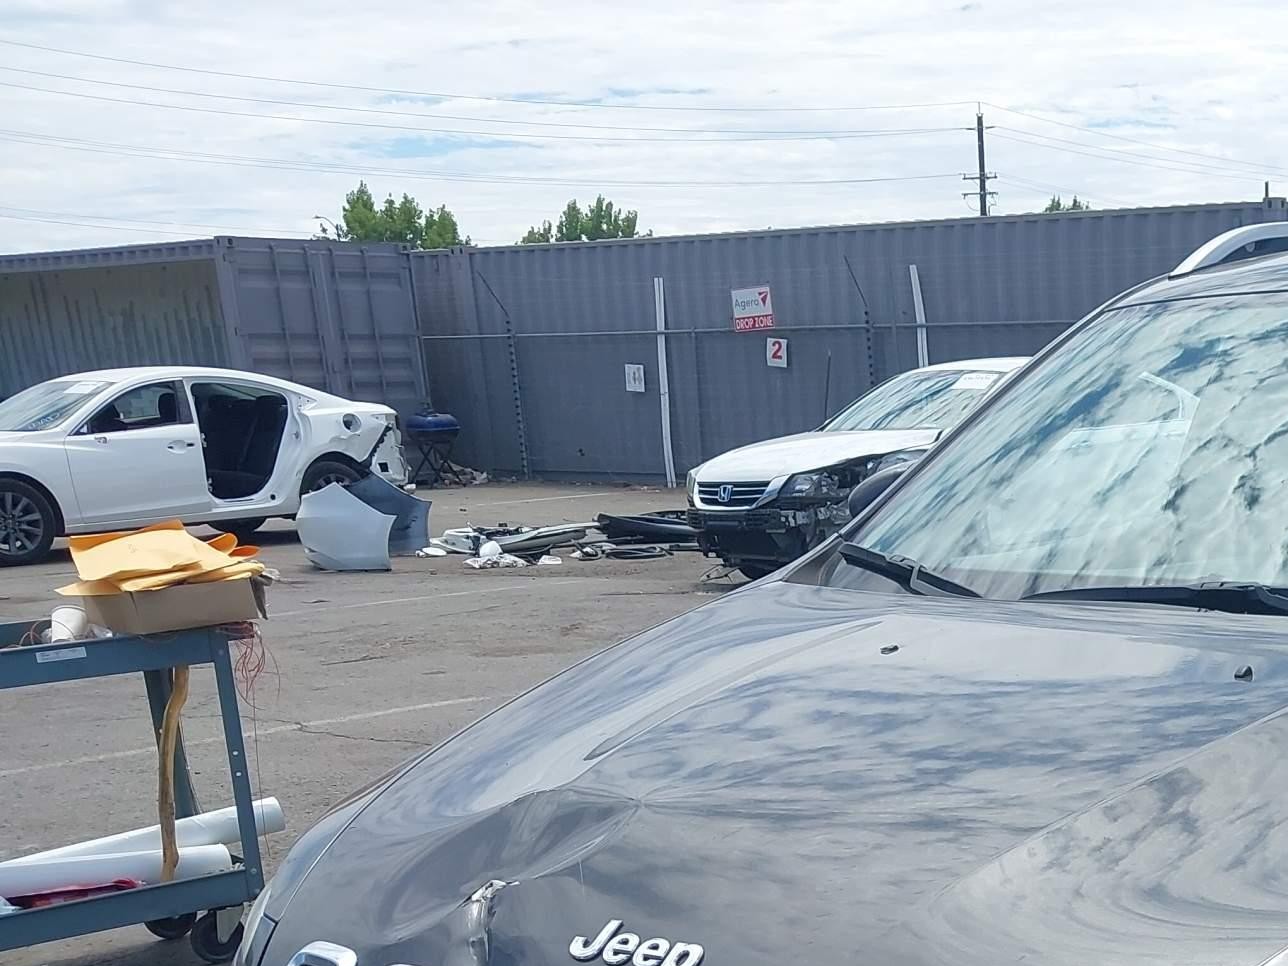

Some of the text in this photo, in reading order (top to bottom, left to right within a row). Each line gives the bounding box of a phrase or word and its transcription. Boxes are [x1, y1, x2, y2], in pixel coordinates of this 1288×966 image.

[736, 316, 774, 330] DROP ZONE
[771, 340, 783, 360] 2
